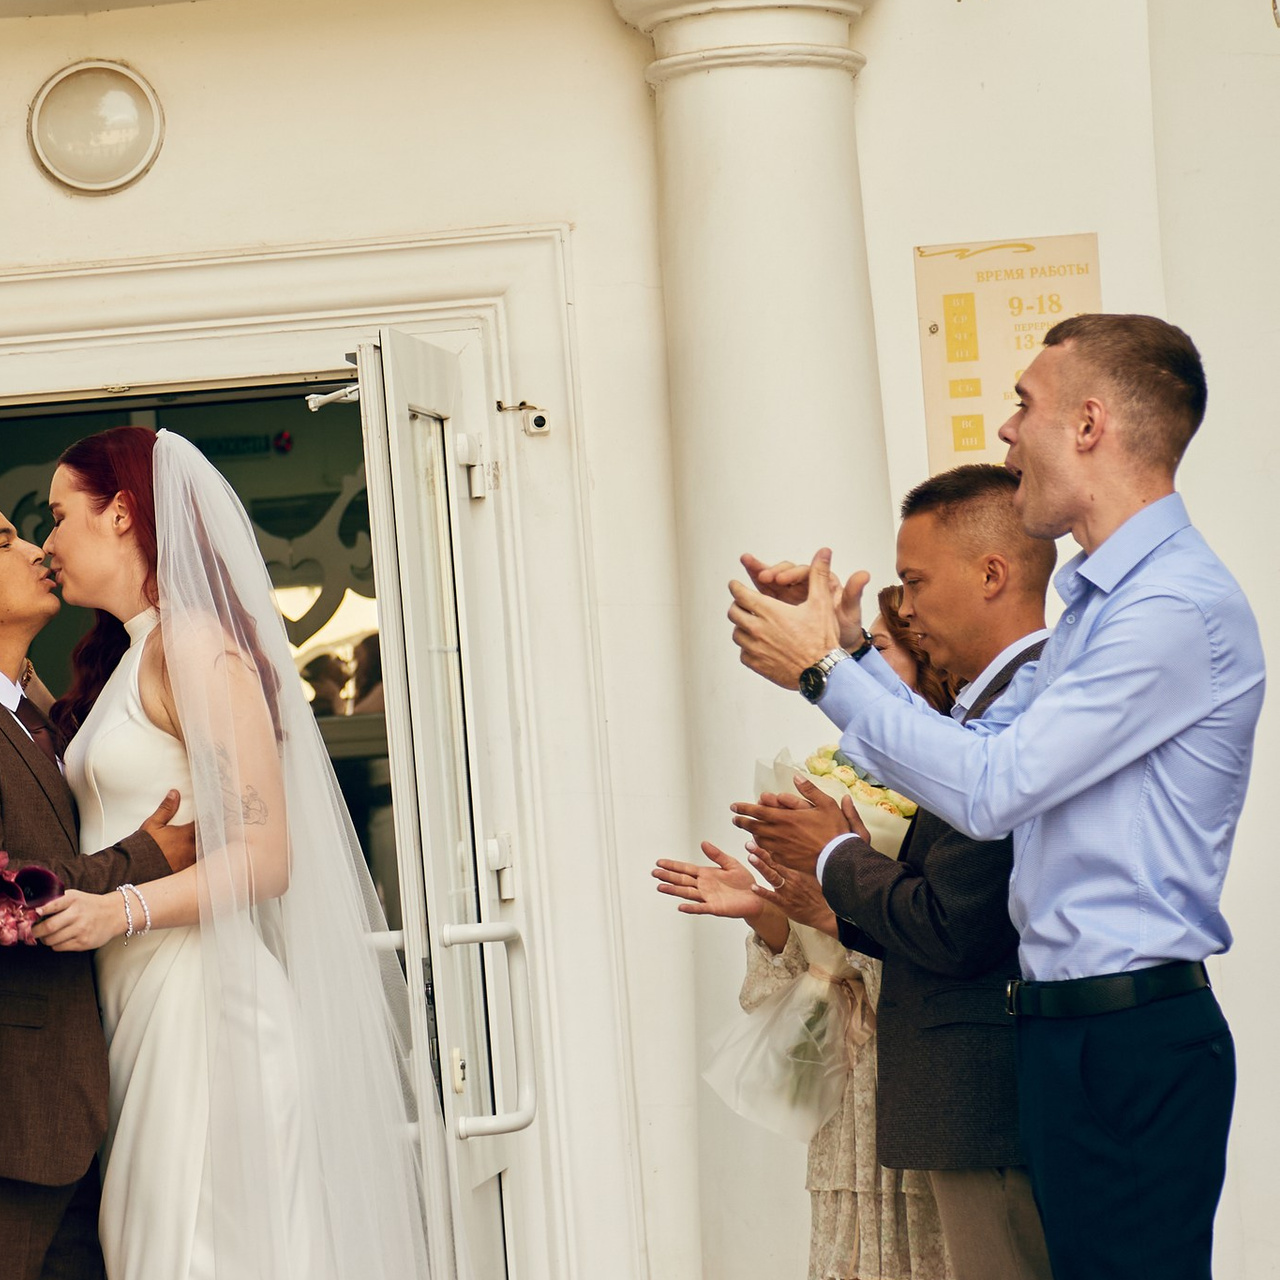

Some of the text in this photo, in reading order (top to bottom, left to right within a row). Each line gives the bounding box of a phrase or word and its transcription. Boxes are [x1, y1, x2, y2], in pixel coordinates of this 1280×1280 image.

[976, 263, 1089, 283] ВРЕМЯ РАБОТЫ
[1008, 293, 1063, 317] 9-18
